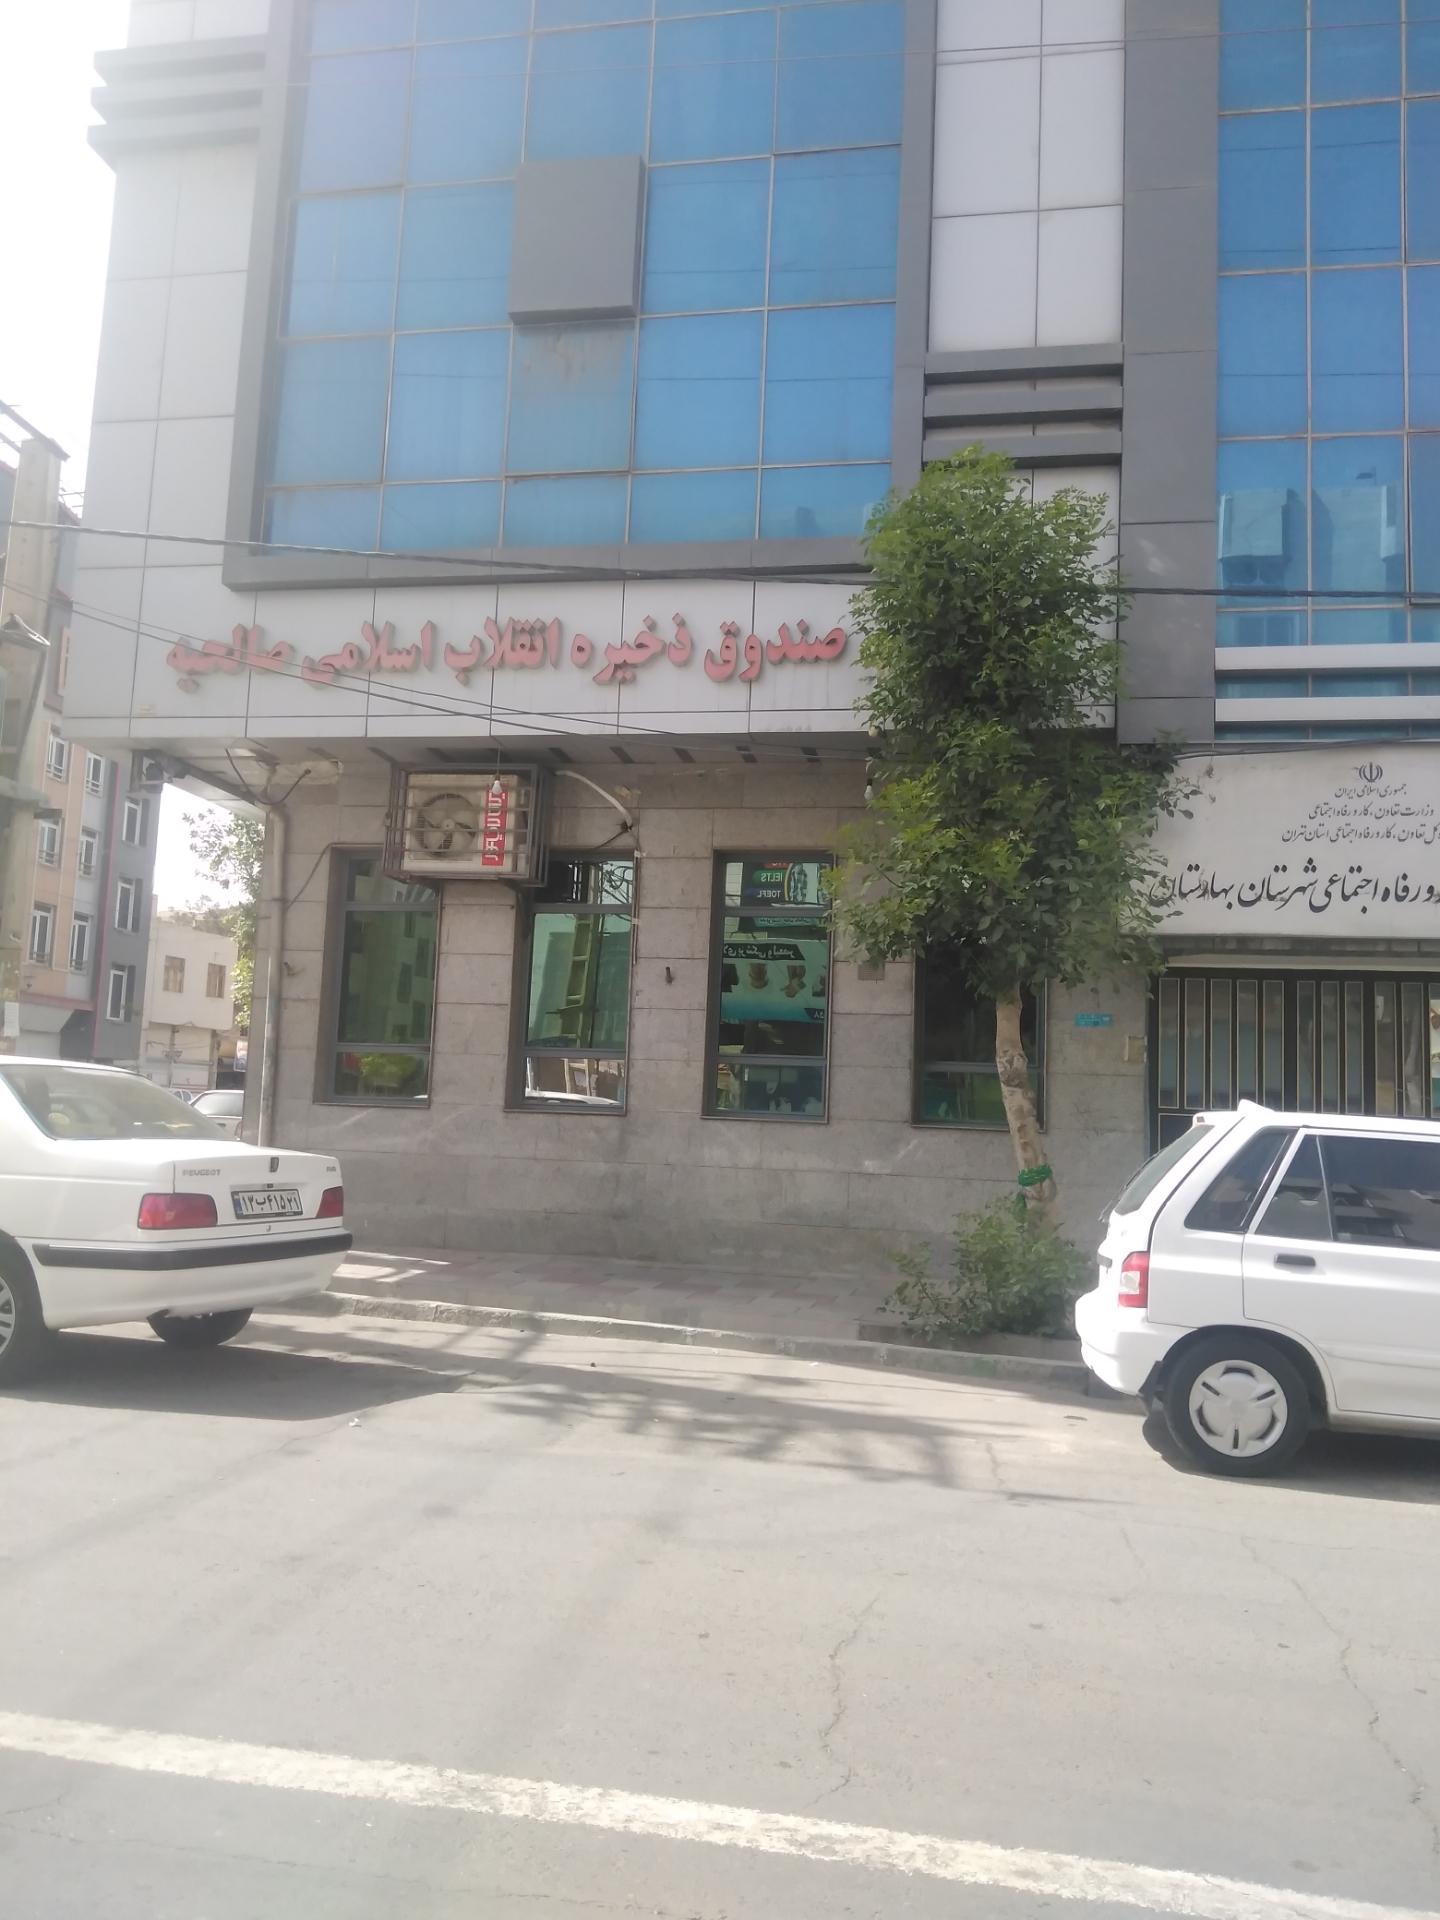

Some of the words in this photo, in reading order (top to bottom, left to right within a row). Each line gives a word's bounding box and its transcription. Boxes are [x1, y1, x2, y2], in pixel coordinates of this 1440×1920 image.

[166, 623, 295, 694] صالحیه
[301, 619, 438, 689] اسلامی
[443, 616, 563, 687] انقلاب
[569, 612, 693, 686] ذخیره
[703, 618, 848, 683] صندوق
[1334, 787, 1356, 800] ایران
[1357, 784, 1379, 798] اسلامی
[1379, 783, 1407, 798] جمهوری
[1308, 801, 1336, 820] اجتماعی
[1359, 801, 1373, 816] کار
[1400, 803, 1434, 817] وزارت
[1282, 824, 1307, 843] تهران
[1304, 823, 1329, 842] استان
[1330, 823, 1357, 844] اجتماعی
[1380, 822, 1396, 839] کار
[1237, 857, 1319, 911] شهرستان
[1308, 865, 1379, 914] اجتماعی
[1381, 872, 1421, 903] رفاه
